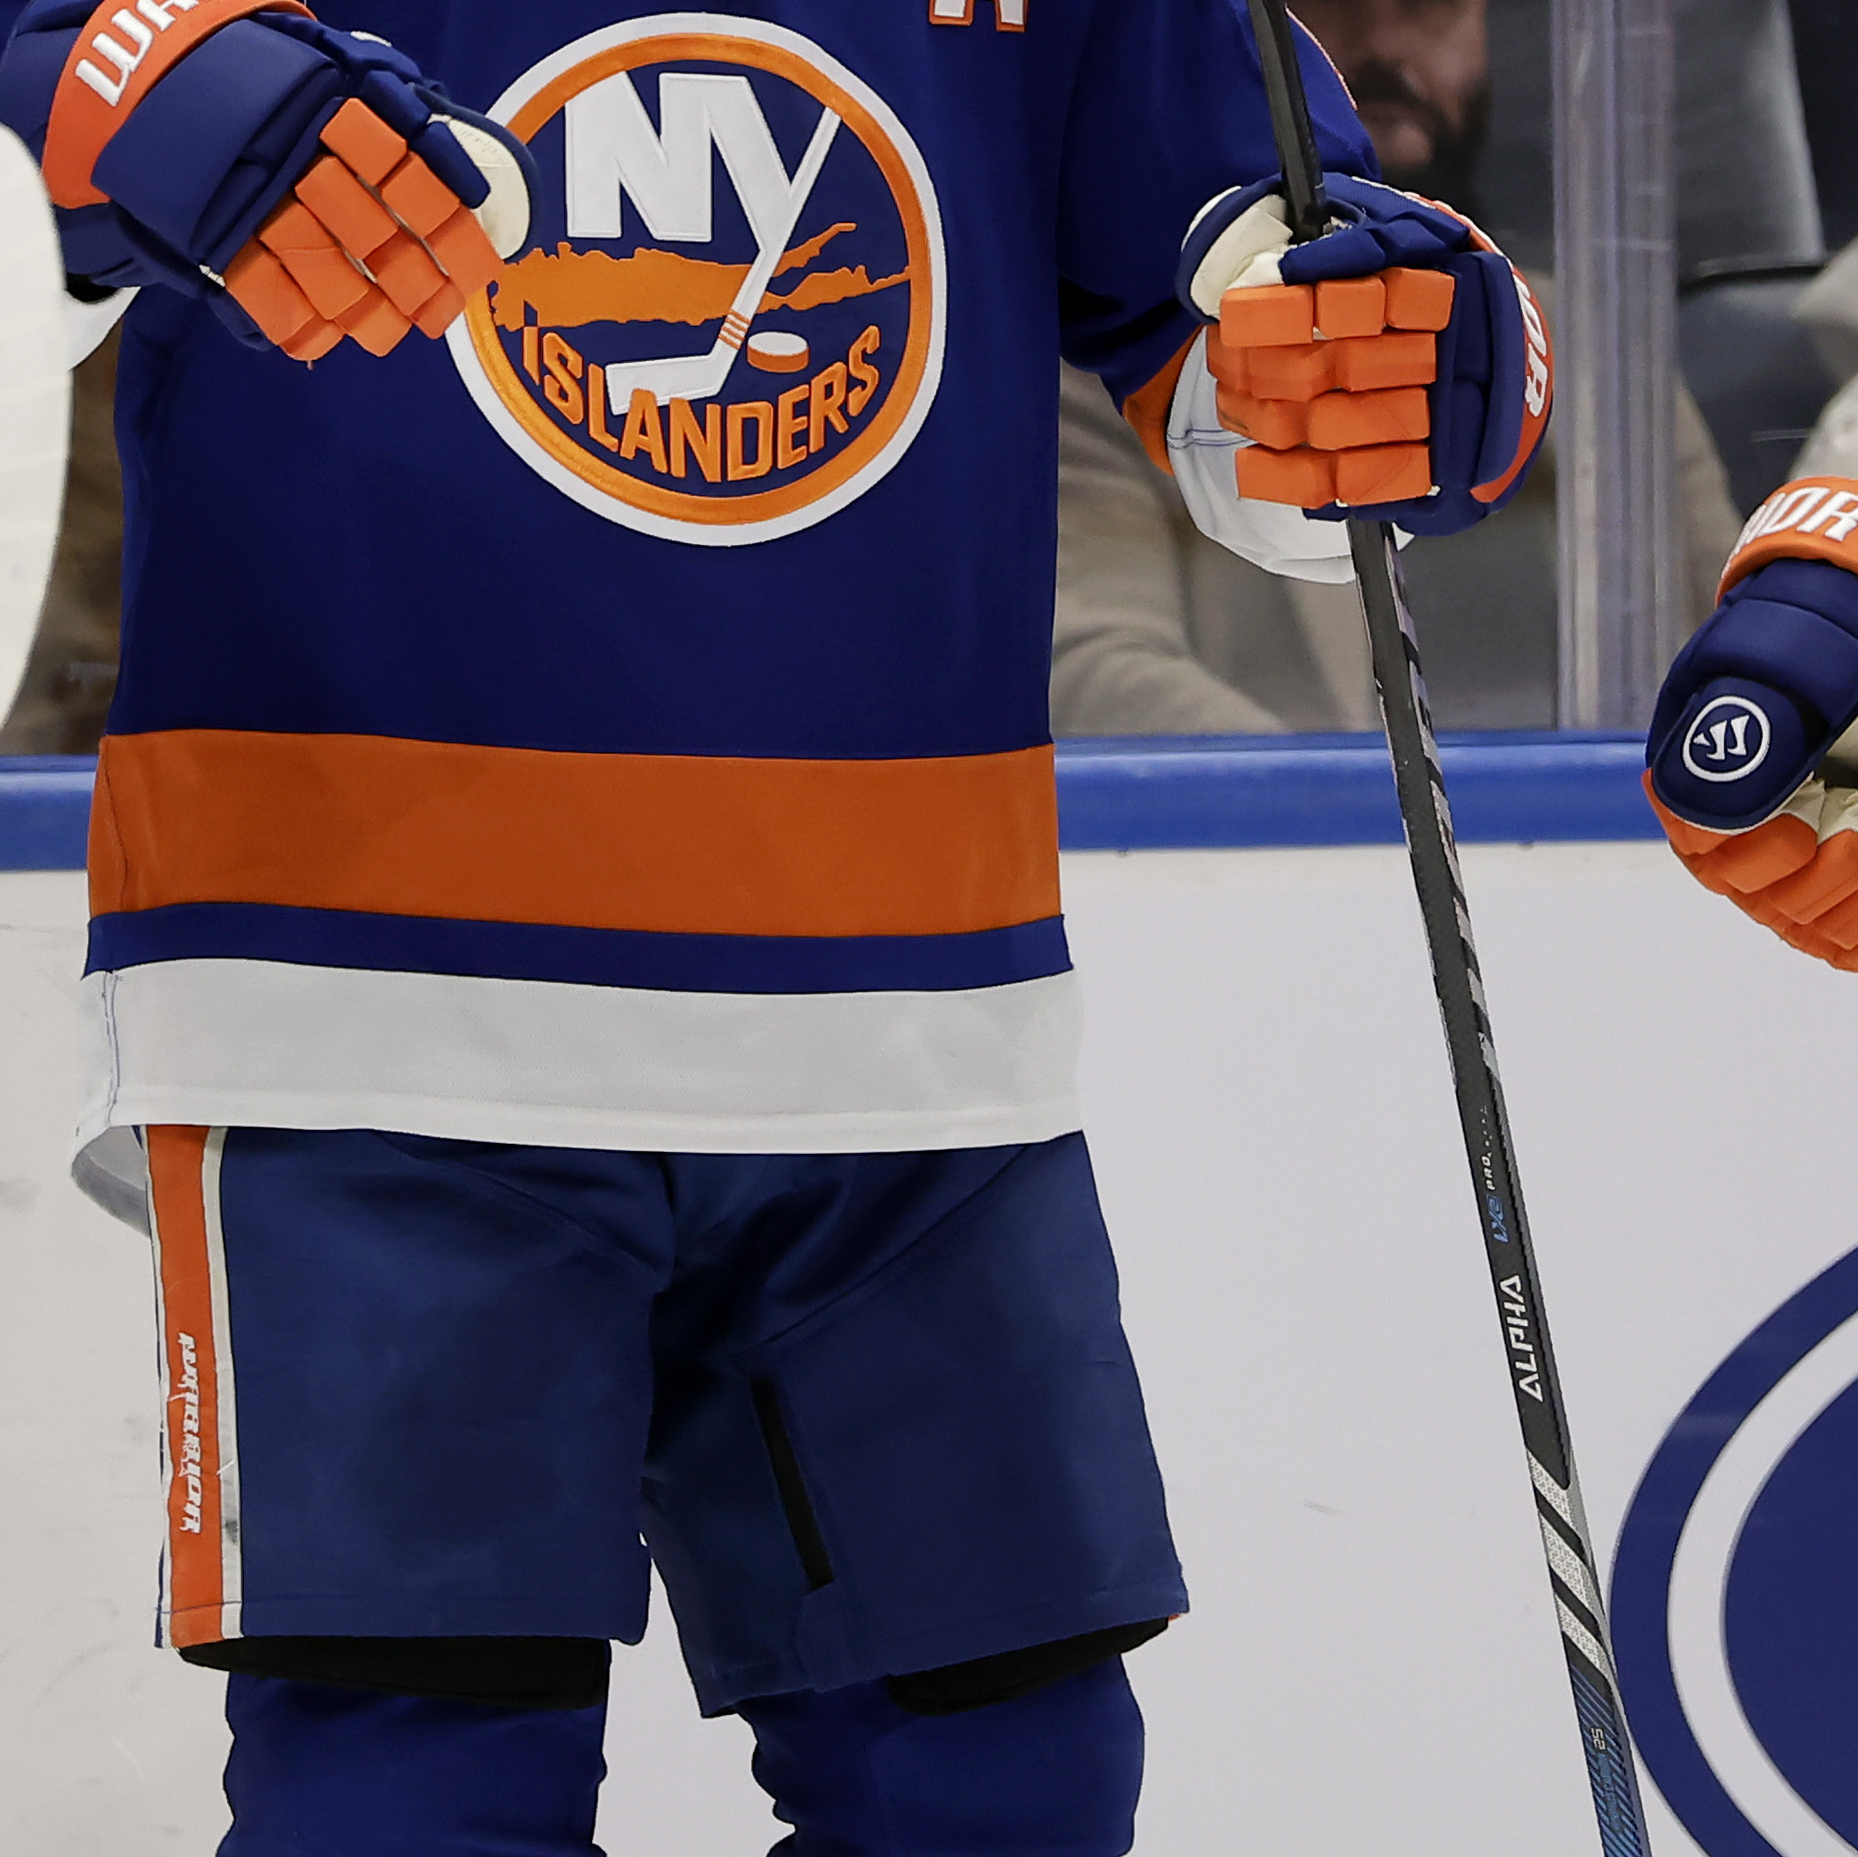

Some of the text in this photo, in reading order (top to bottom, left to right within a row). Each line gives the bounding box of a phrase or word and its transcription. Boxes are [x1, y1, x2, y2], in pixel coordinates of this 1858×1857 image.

[564, 70, 845, 254] NY
[521, 298, 883, 484] ISLANDERS
[1499, 1274, 1544, 1403] ALPHA
